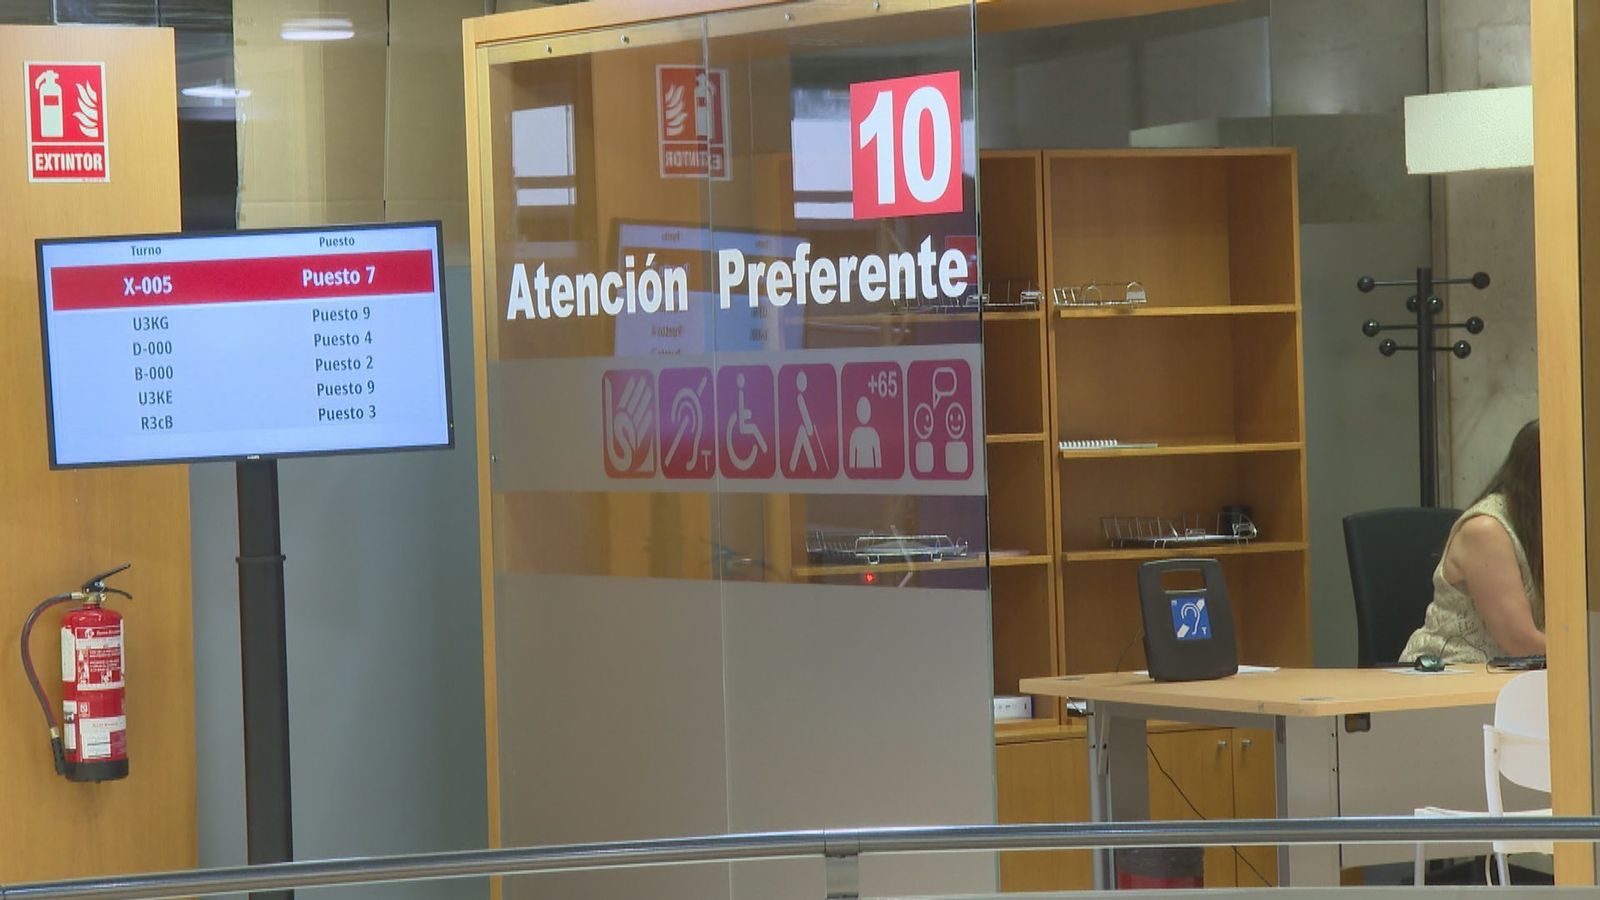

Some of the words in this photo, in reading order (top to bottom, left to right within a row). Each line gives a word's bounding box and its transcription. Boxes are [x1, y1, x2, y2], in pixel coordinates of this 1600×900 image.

[859, 86, 952, 205] 10
[35, 152, 103, 171] EXTINTOR
[319, 236, 355, 248] Puesto
[131, 245, 162, 257] Turno
[302, 268, 361, 288] Puesto
[365, 265, 376, 284] 7
[507, 253, 689, 320] Atención
[718, 234, 969, 310] Preferente
[123, 275, 173, 296] X-005
[312, 307, 358, 323] Puesto
[362, 306, 371, 320] 9
[133, 316, 169, 331] U3KG
[314, 332, 360, 347] Puesto
[364, 330, 373, 345] 4
[132, 341, 172, 356] D-000
[315, 356, 361, 372] Puesto
[366, 355, 373, 370] 2
[134, 365, 174, 381] B-000
[317, 381, 363, 397] Puesto
[367, 379, 375, 395] 9
[867, 370, 898, 398] +65
[138, 390, 173, 406] U3KE
[318, 405, 364, 422] Puesto
[368, 403, 377, 420] 3
